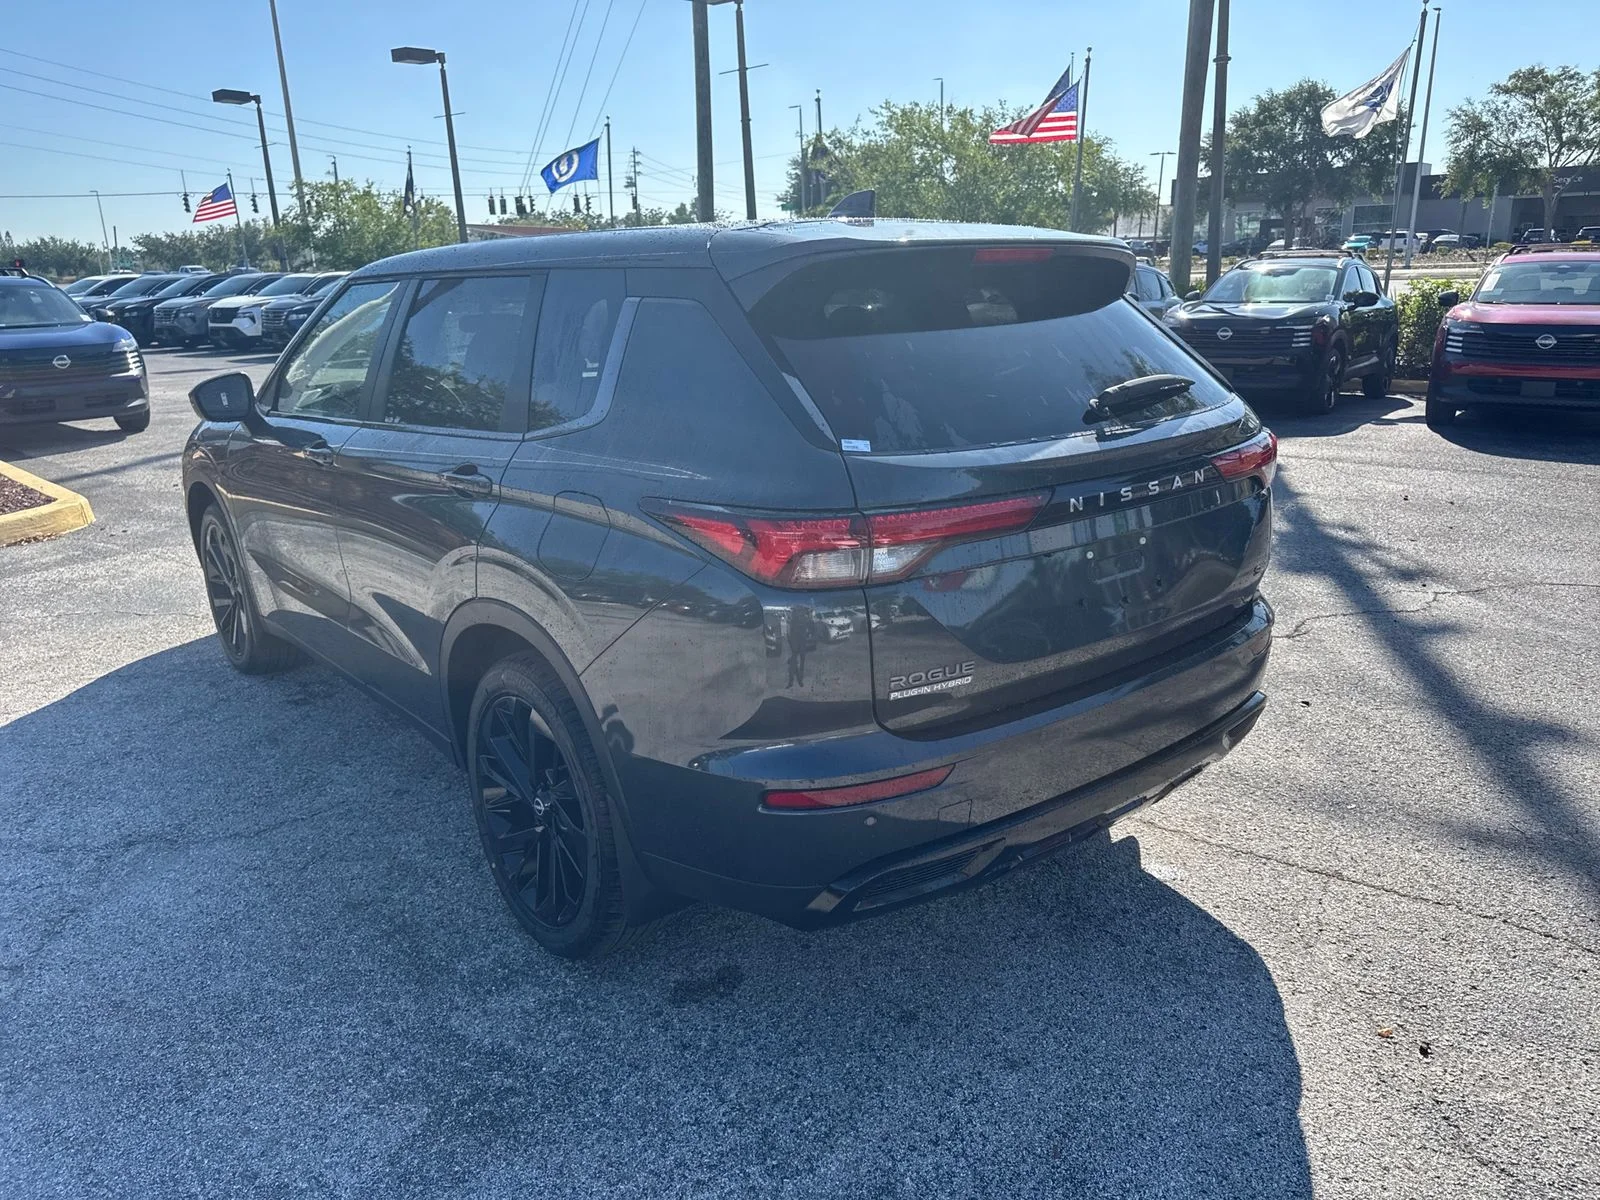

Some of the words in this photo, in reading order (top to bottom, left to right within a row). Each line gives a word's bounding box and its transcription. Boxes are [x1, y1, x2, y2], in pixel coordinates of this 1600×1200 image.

[1553, 175, 1583, 185] Servce
[1069, 469, 1205, 513] NISSAN
[889, 660, 976, 690] ROGUE
[889, 685, 931, 701] PLUG-IN
[933, 676, 973, 691] HYBRID
